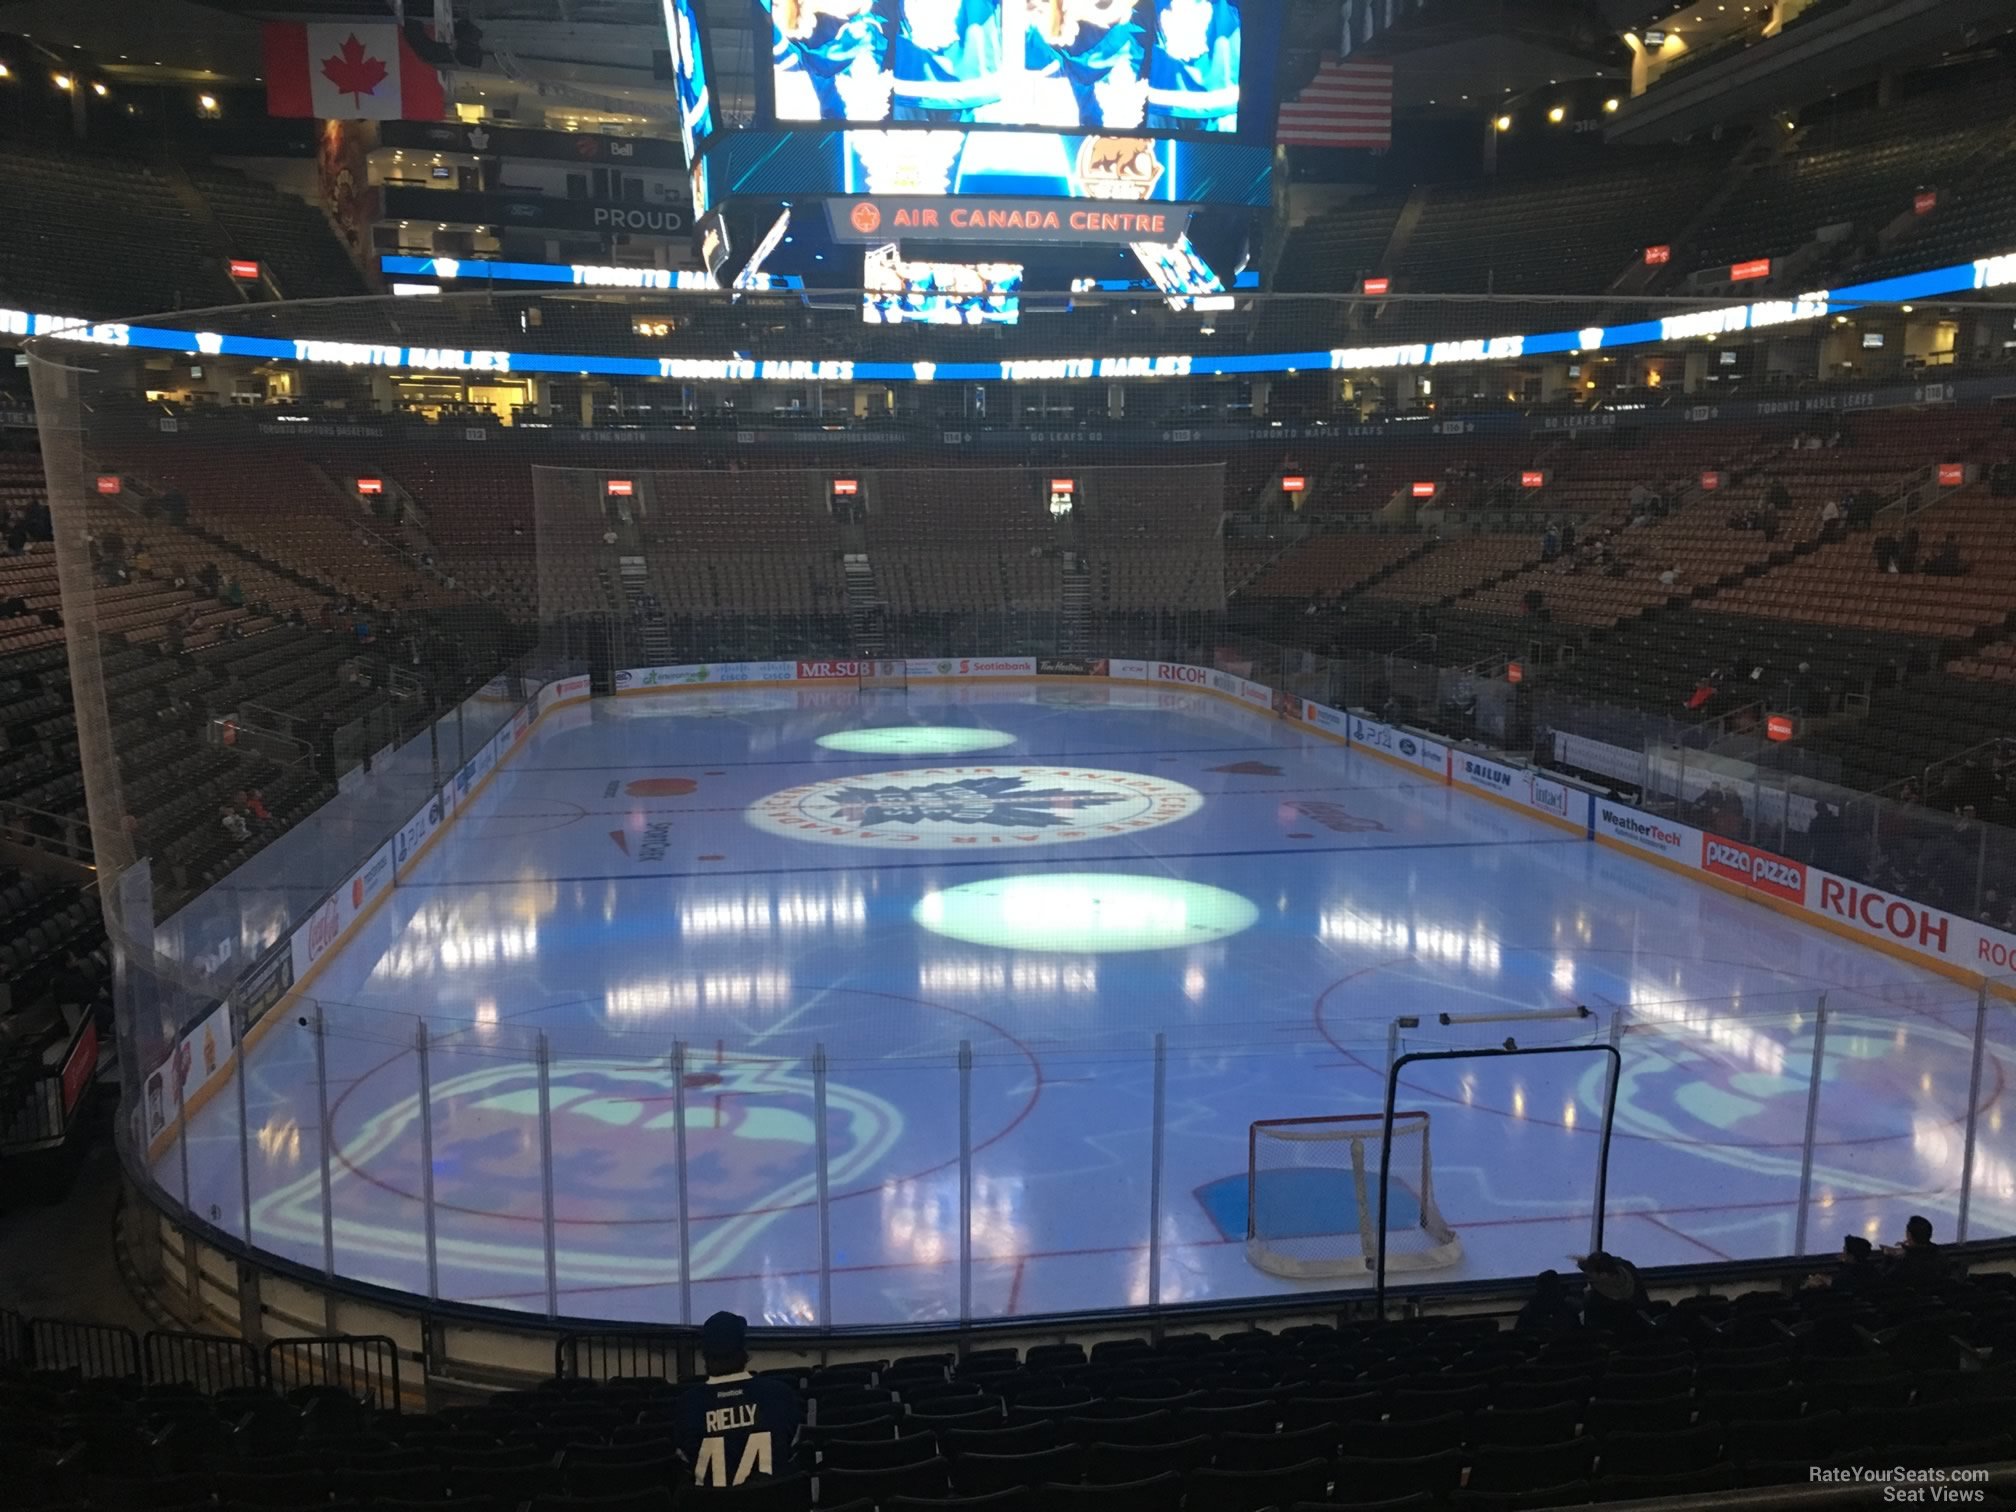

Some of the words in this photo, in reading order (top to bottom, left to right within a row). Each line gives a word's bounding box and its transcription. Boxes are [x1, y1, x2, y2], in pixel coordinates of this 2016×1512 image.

[611, 142, 632, 156] Bell
[594, 208, 681, 230] PROUD
[893, 208, 940, 227] AIR
[950, 208, 1060, 229] CANADA
[1069, 212, 1165, 232] CENTRE
[294, 339, 402, 367] TORONTO
[408, 346, 511, 373] MARLIES
[1330, 343, 1427, 370] TORONTO
[1429, 335, 1525, 365] MARLIES
[659, 358, 755, 379] TORONTO
[762, 360, 854, 380] MARLIES
[1000, 358, 1094, 380] TORONTO
[1099, 356, 1192, 377] MARLIES
[1757, 400, 1801, 415] TORONTO
[1805, 396, 1837, 411] MAPLE
[1842, 393, 1874, 408] LEAFS
[1249, 429, 1297, 439] TORONTO
[1304, 428, 1340, 437] MAPLE
[1347, 426, 1384, 437] LEAFS
[1545, 418, 1558, 428] GO
[1563, 416, 1595, 427] LEAFS
[1602, 414, 1616, 425] GO
[1030, 432, 1045, 442] GO
[1050, 432, 1084, 442] LEAFS
[1089, 432, 1103, 442] GO
[801, 662, 870, 677] MR.SUB
[973, 661, 1031, 672] Scotiabank
[1158, 664, 1207, 685] RICOH
[1465, 760, 1511, 786] SAILUN
[1602, 808, 1681, 847] WeatherTech
[1706, 841, 1750, 873] pizza
[1752, 855, 1801, 891] pizza
[1820, 876, 1949, 953] RICOH
[705, 1403, 757, 1433] RIELLY
[694, 1431, 773, 1487] 44
